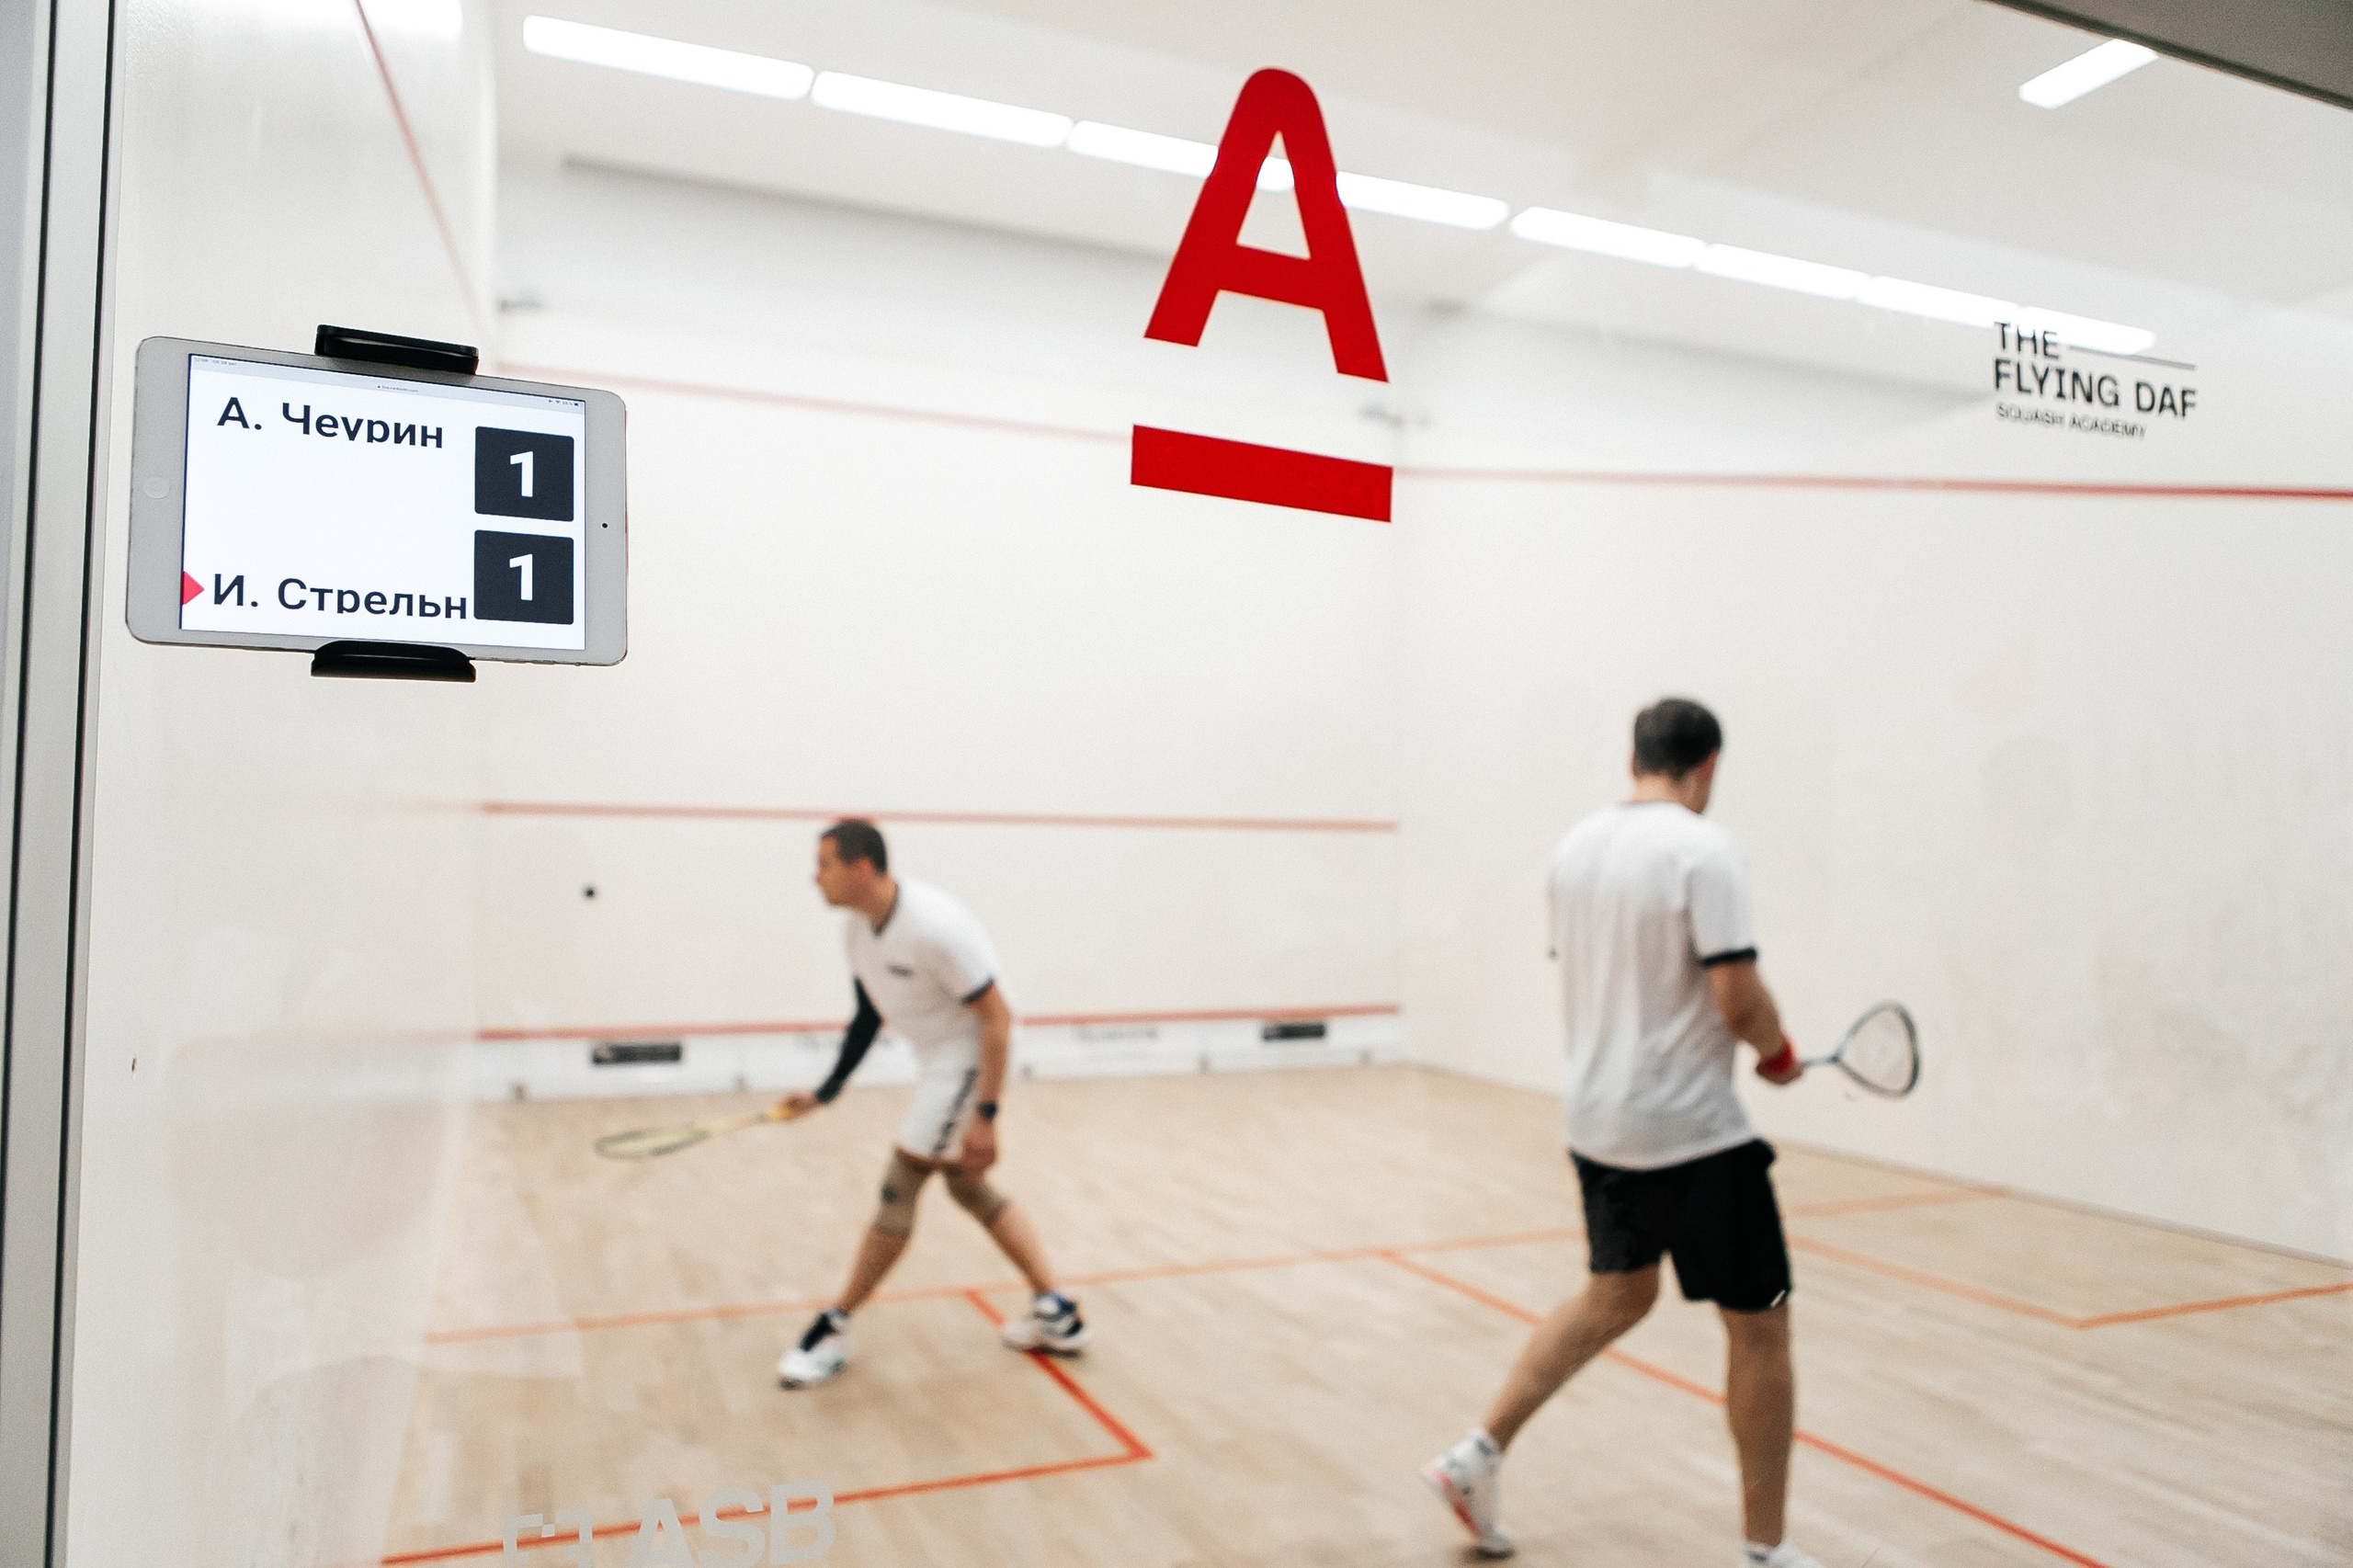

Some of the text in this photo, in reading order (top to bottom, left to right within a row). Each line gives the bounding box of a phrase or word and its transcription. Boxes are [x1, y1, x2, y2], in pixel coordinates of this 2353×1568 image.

[1994, 321, 2059, 359] THE
[1994, 358, 2198, 418] FLYING DAF
[509, 450, 534, 498] 1
[213, 573, 467, 619] И. Стрельн
[509, 553, 533, 601] 1
